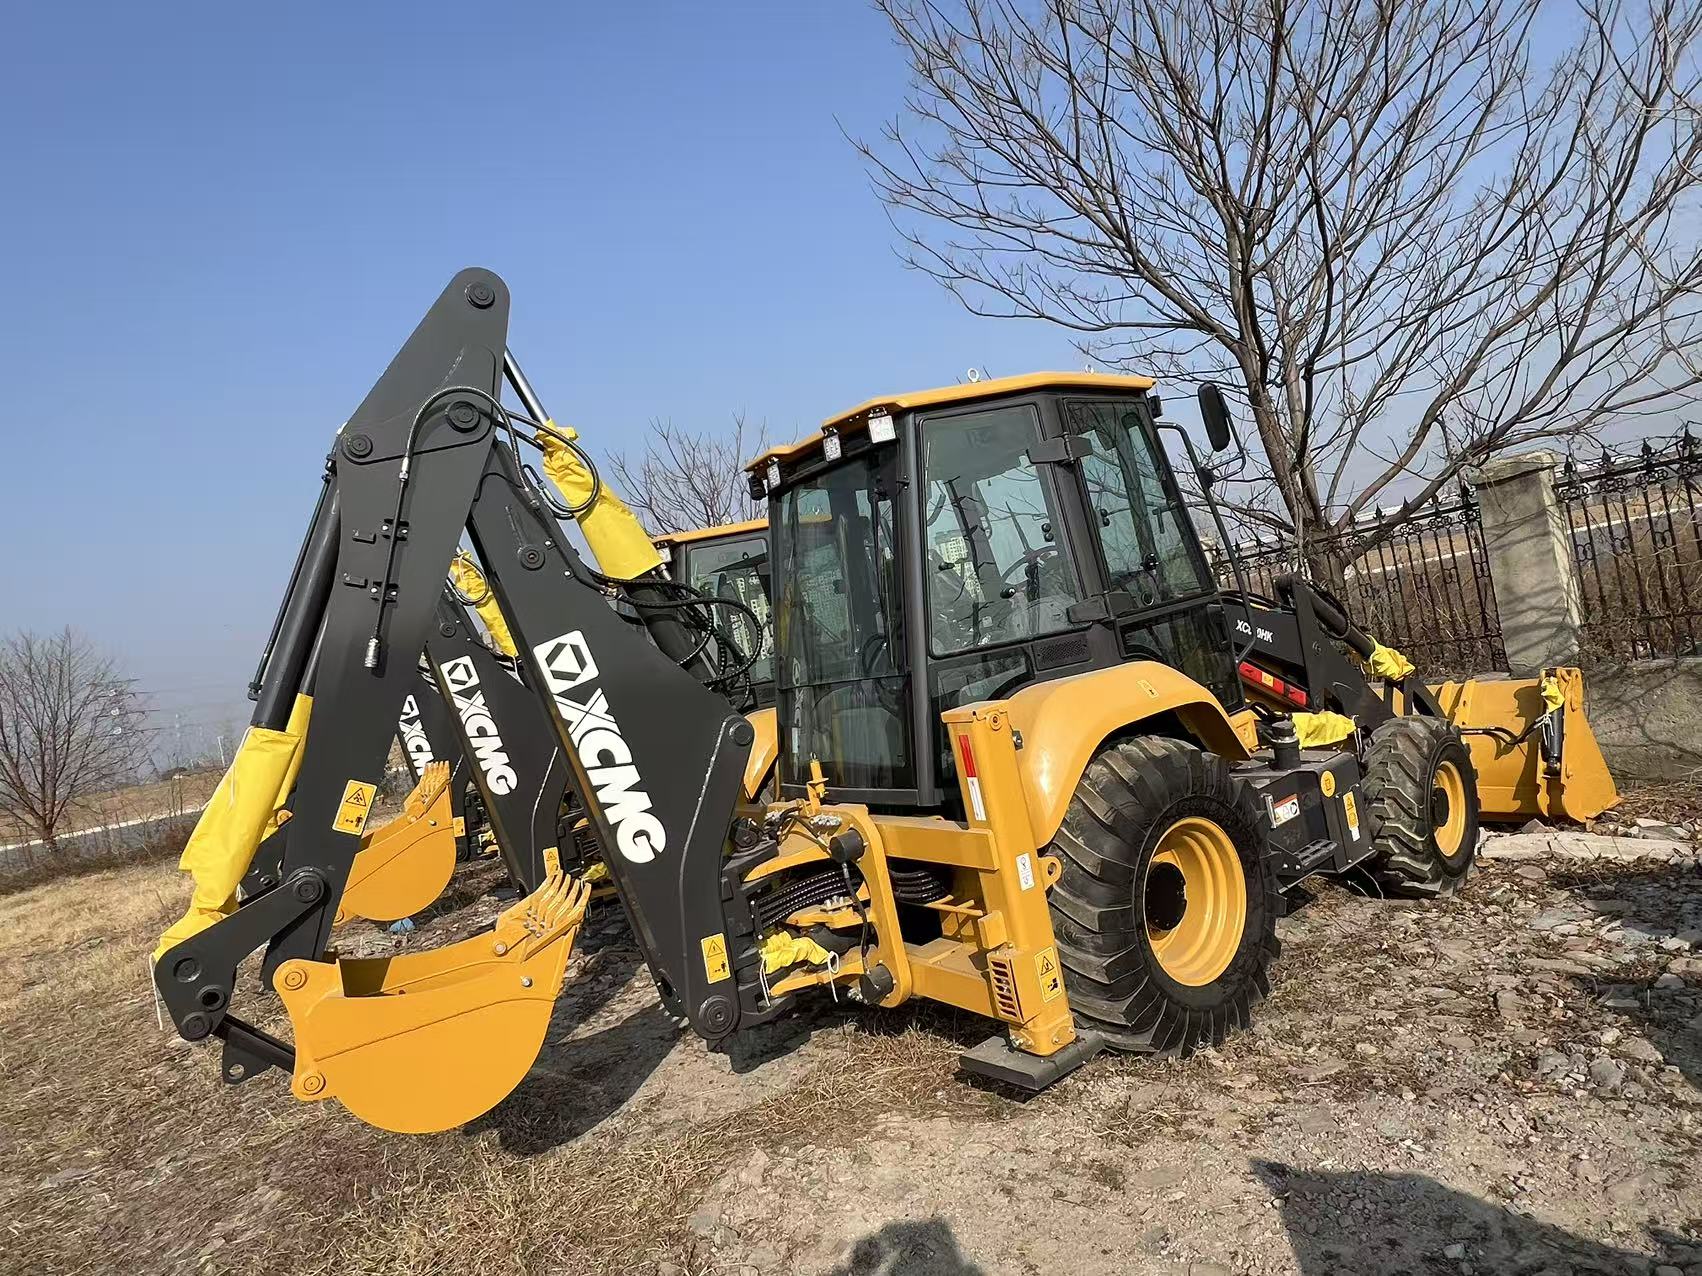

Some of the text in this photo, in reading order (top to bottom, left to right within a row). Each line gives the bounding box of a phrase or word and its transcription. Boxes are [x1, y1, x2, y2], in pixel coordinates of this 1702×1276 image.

[1236, 620, 1274, 643] XC0HK
[399, 720, 434, 776] XCM
[453, 691, 518, 795] XCMG
[554, 689, 666, 863] XCMG
